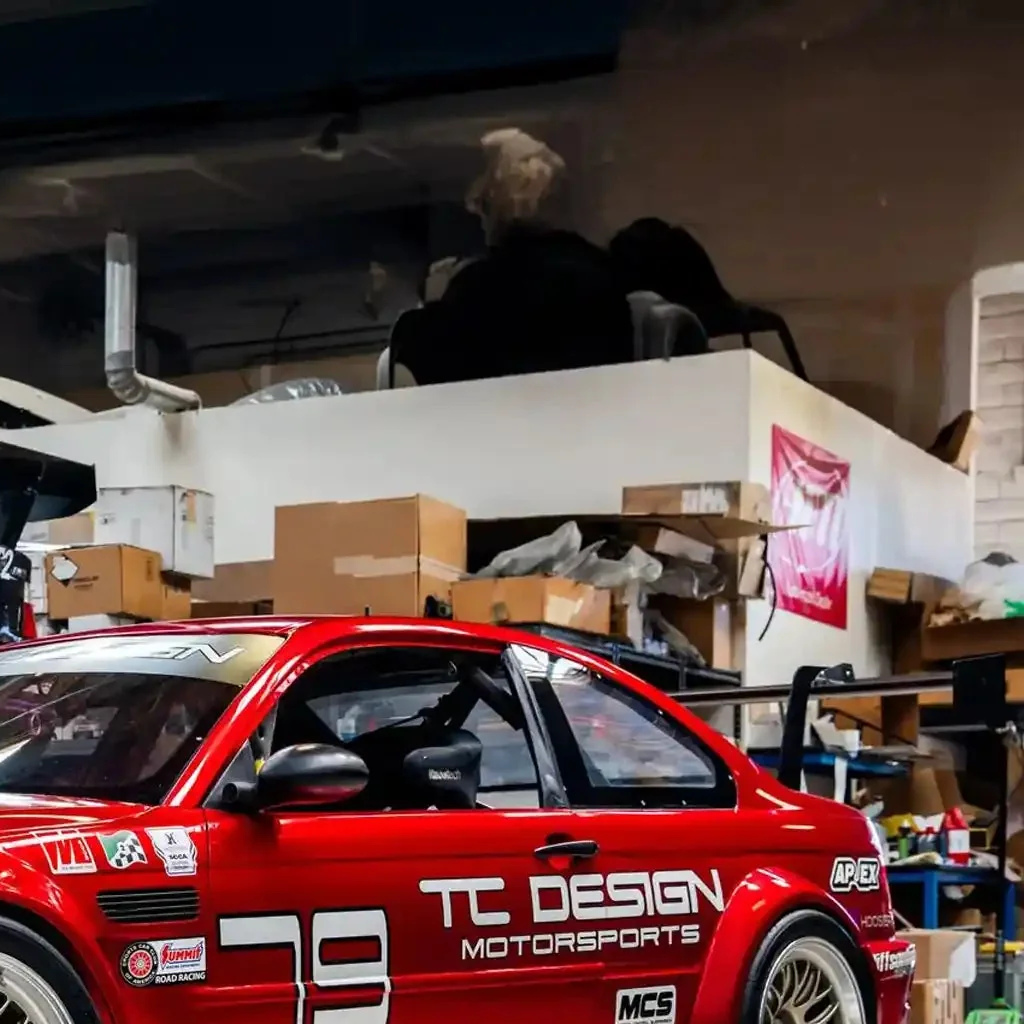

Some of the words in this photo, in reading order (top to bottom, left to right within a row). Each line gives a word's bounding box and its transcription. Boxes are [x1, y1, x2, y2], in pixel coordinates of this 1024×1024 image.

[418, 877, 511, 928] TC
[529, 869, 725, 923] DESIGN
[461, 924, 701, 959] MOTORSPORTS
[155, 975, 178, 984] ROAD
[178, 972, 206, 982] RACING
[618, 991, 674, 1021] MCS
